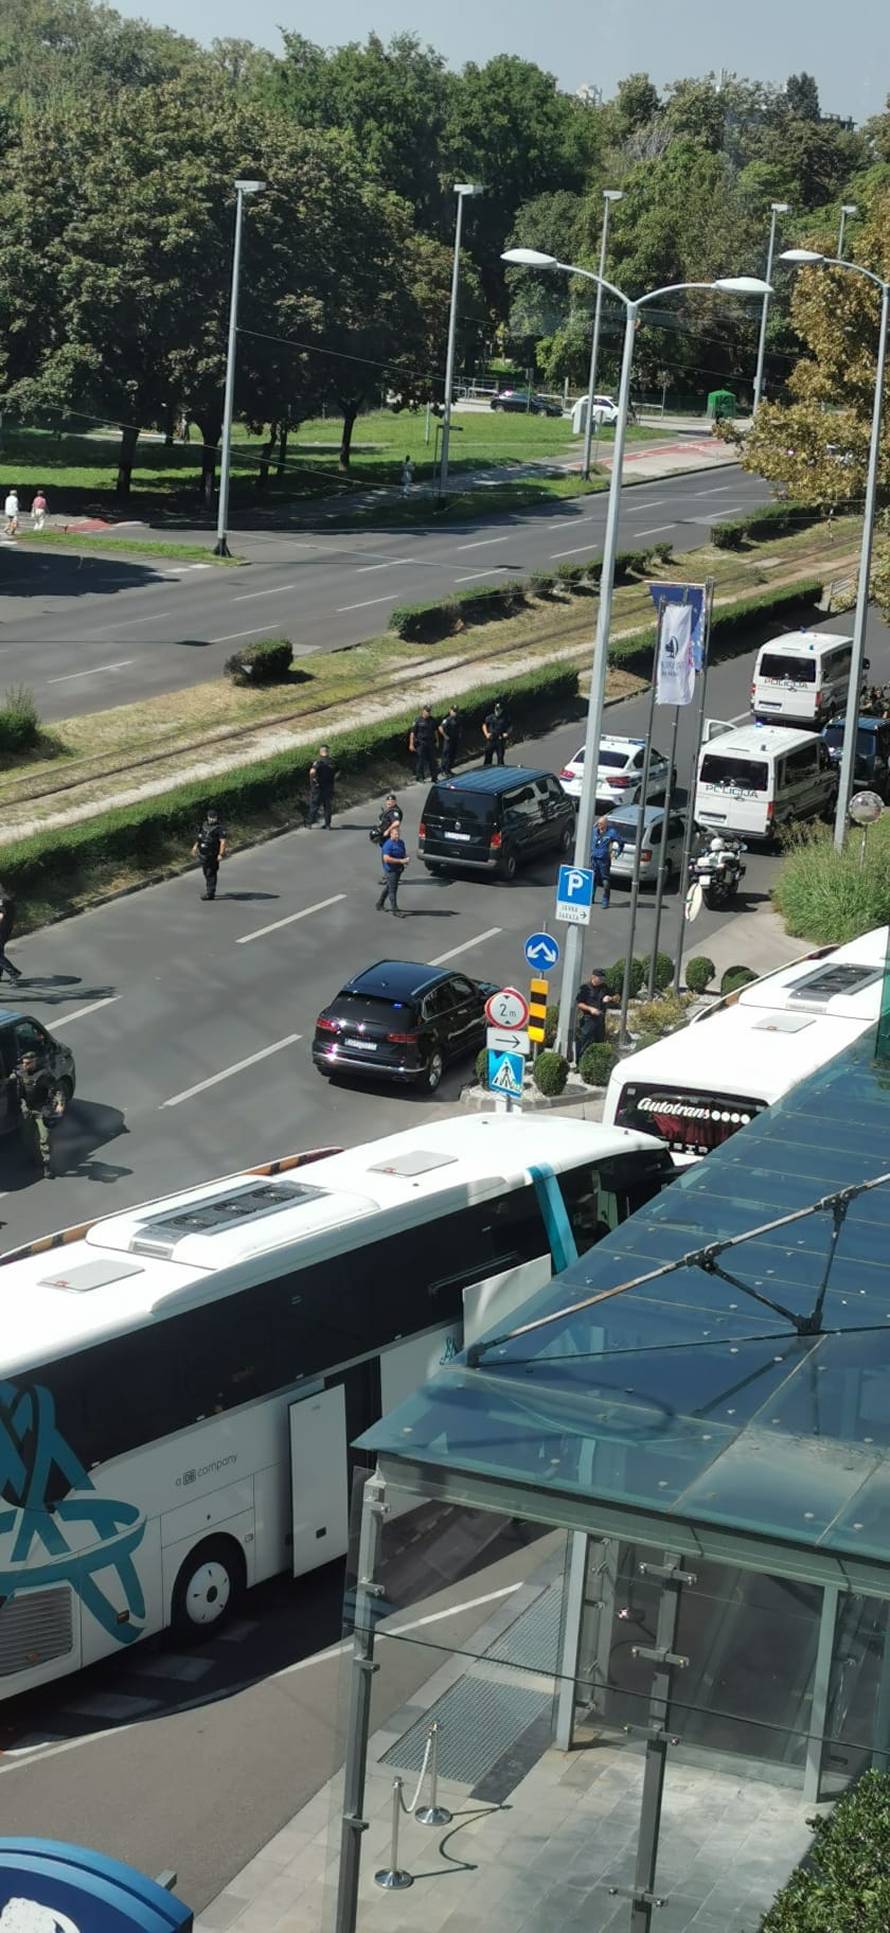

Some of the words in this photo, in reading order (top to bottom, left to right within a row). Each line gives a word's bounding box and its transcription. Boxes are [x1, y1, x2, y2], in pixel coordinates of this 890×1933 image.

[764, 678, 808, 689] POLICIJA
[705, 784, 758, 798] POLICIJA
[568, 874, 583, 896] P
[198, 1454, 238, 1477] company
